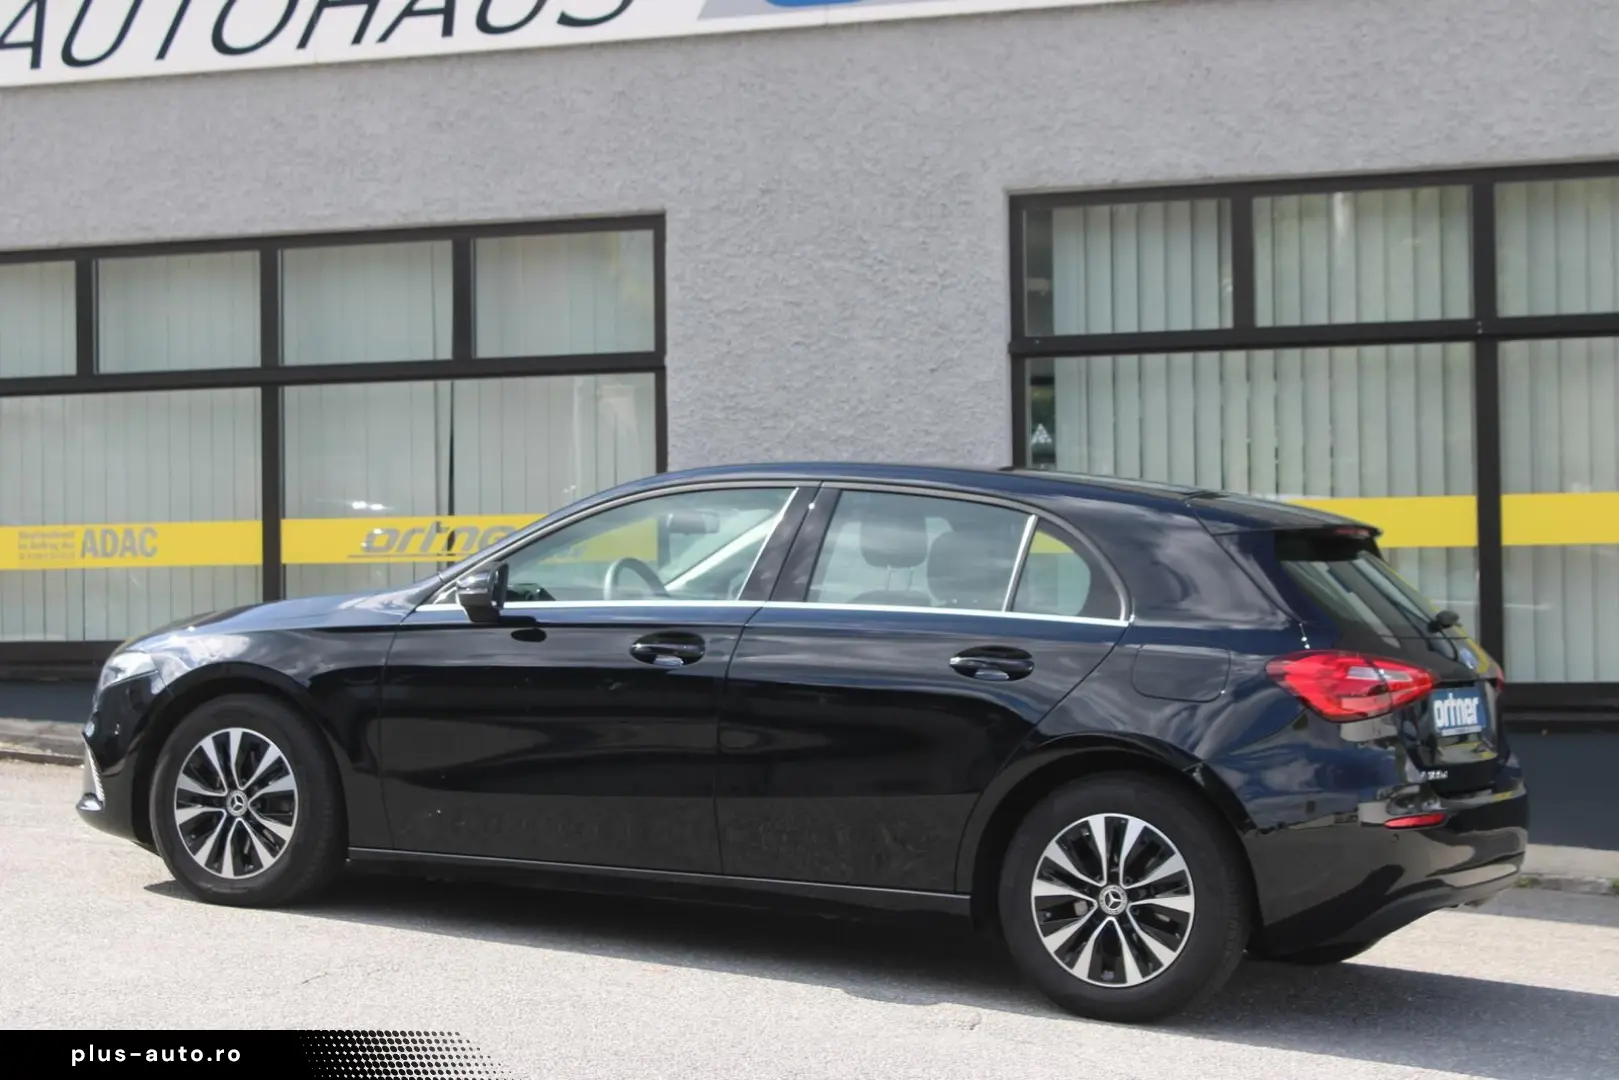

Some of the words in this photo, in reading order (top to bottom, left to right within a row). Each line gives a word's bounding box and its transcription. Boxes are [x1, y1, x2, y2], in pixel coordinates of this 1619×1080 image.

[80, 527, 158, 559] ADAC
[358, 520, 518, 554] ortne
[1433, 692, 1479, 728] ortner
